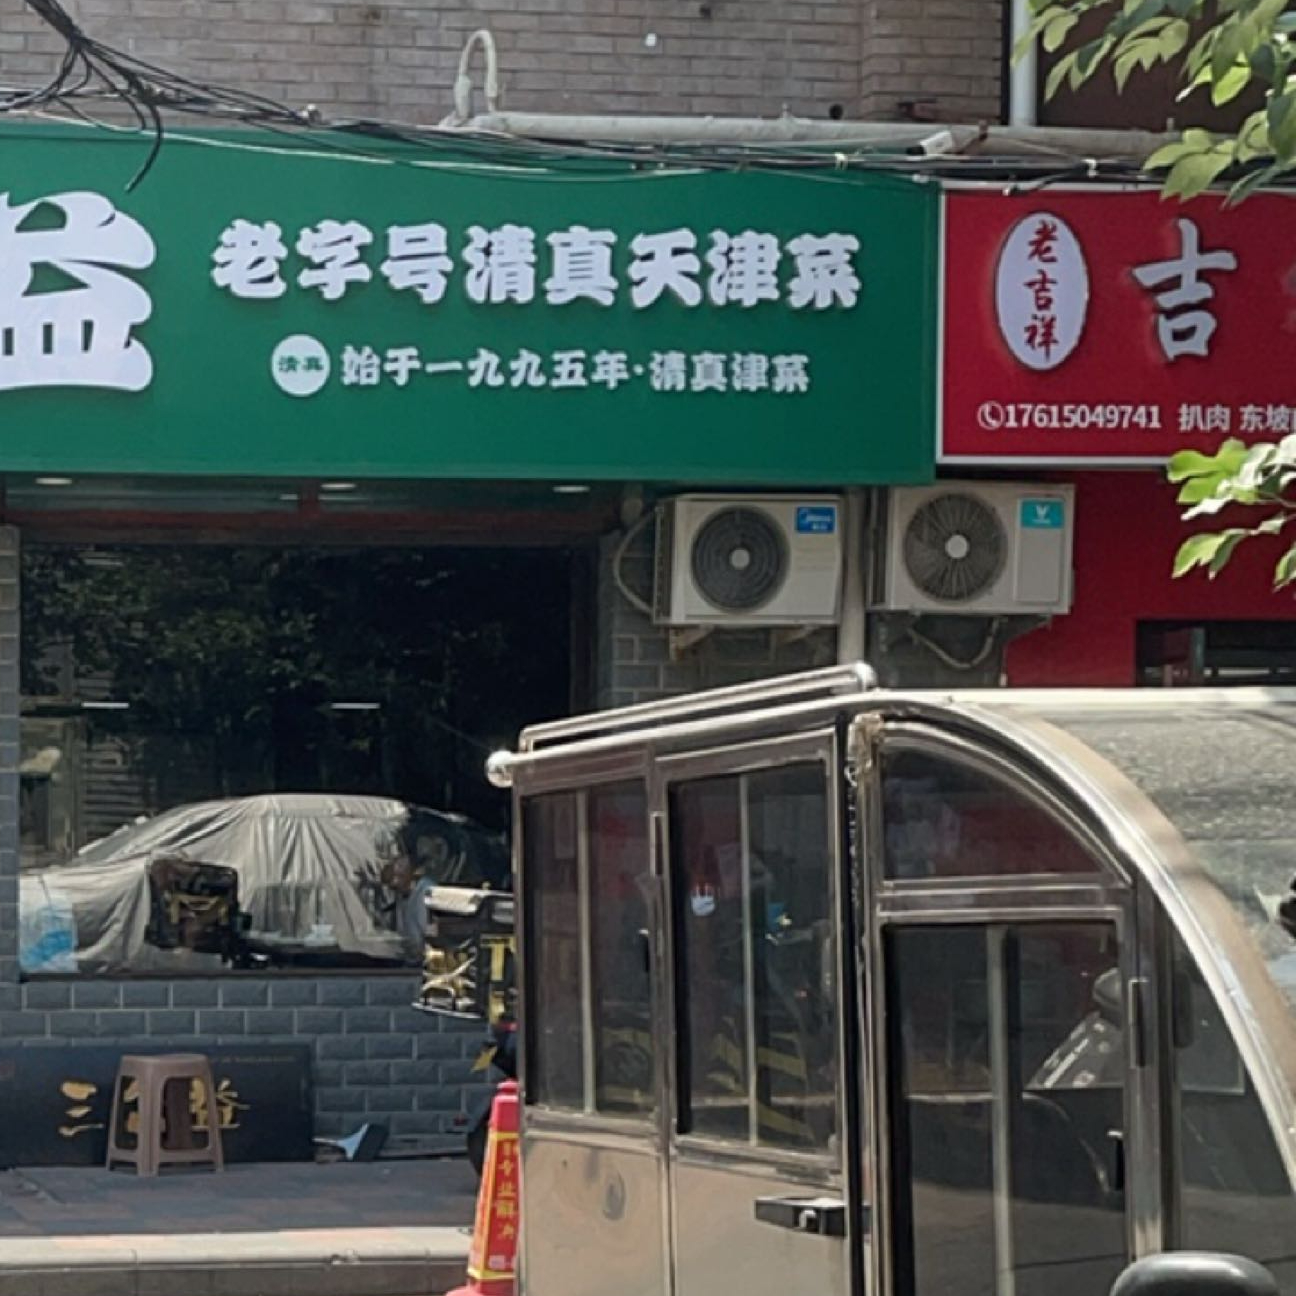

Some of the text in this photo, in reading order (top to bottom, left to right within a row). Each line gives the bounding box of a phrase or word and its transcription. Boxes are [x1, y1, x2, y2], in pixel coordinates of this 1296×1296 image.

[210, 218, 863, 309] 老字号清真天津菜
[1023, 219, 1059, 361] 老吉祥
[1005, 403, 1296, 432] 17615049741 扒肉 东坡
